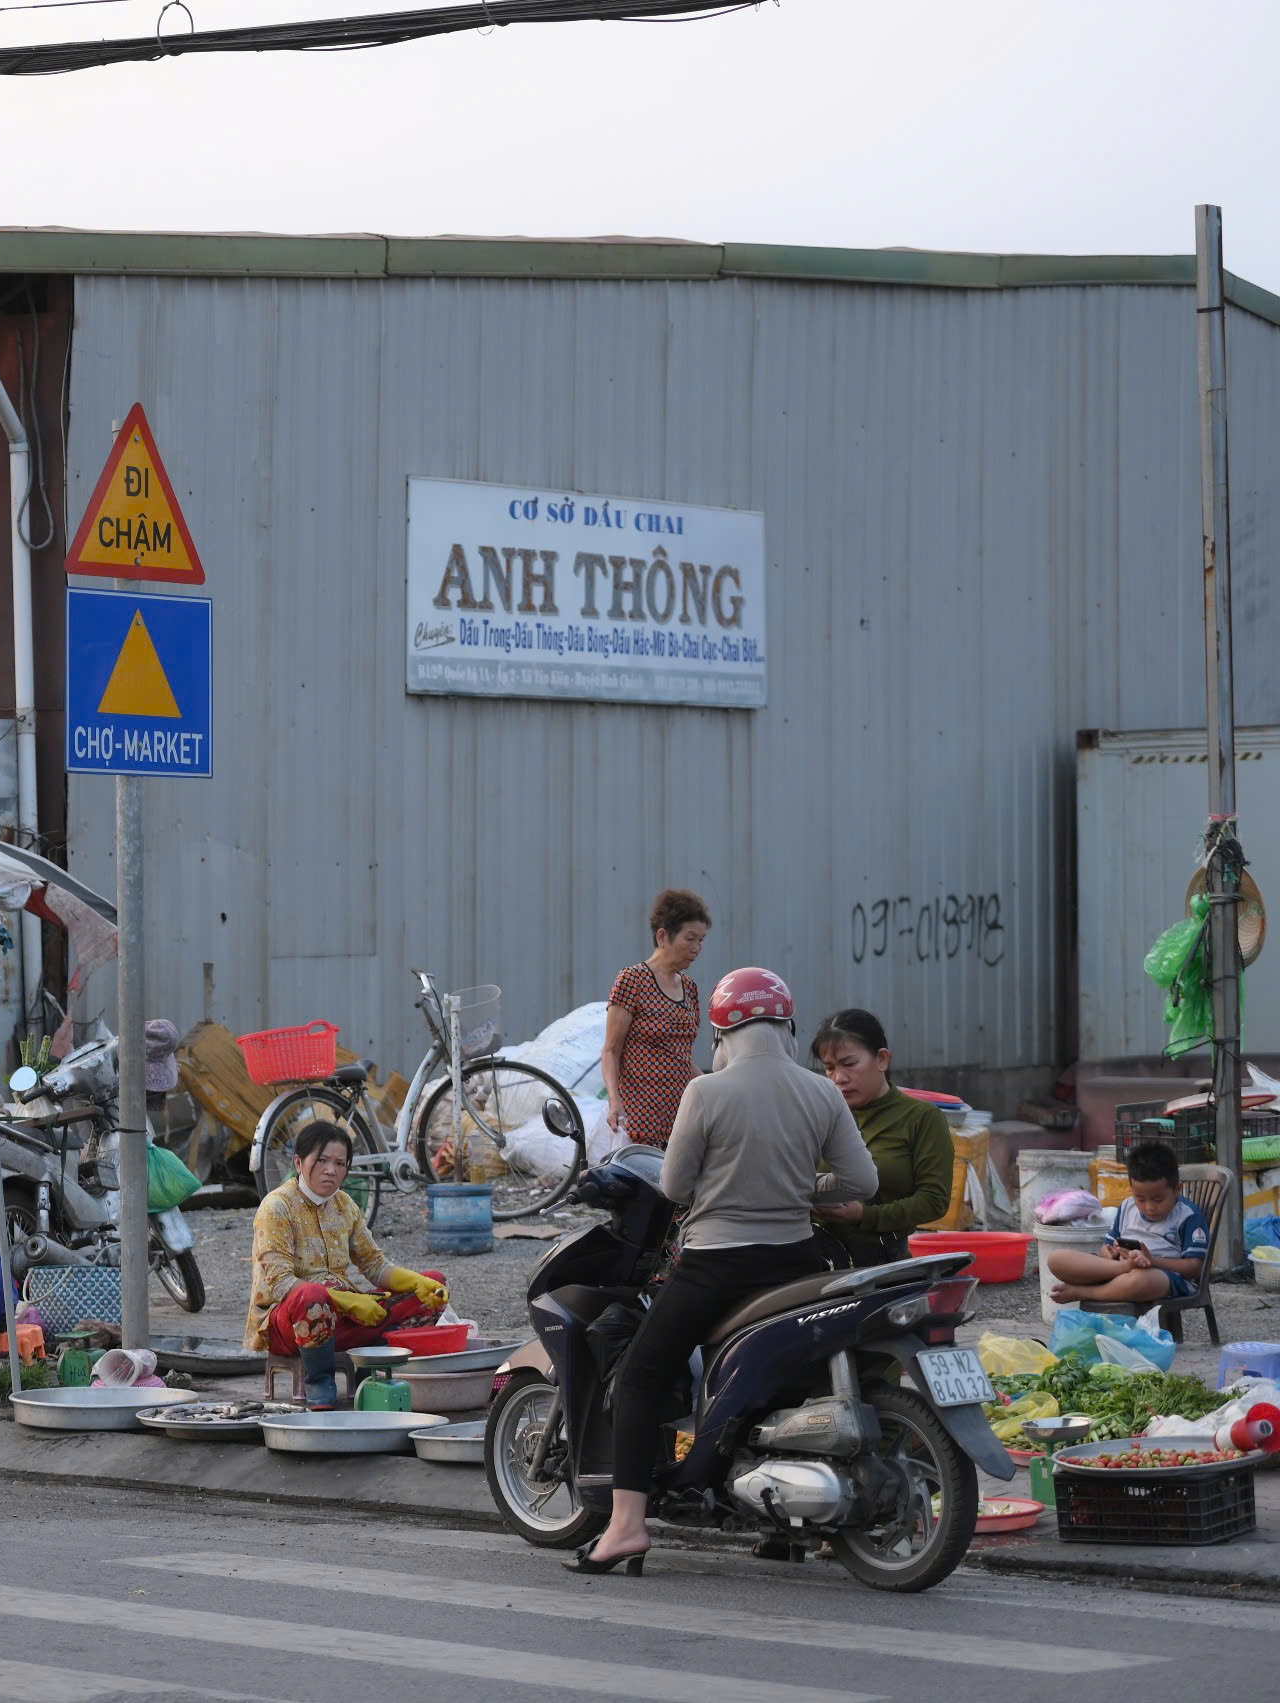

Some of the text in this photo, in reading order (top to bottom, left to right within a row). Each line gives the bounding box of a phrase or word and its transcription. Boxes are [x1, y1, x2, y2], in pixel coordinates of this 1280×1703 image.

[124, 465, 150, 499] ĐI
[98, 512, 172, 557] CHẬM
[508, 496, 539, 521] CƠ
[546, 496, 575, 523] SỞ
[634, 512, 685, 535] CHAI
[432, 543, 745, 628] ANH THÔNG
[797, 1301, 862, 1327] VISION
